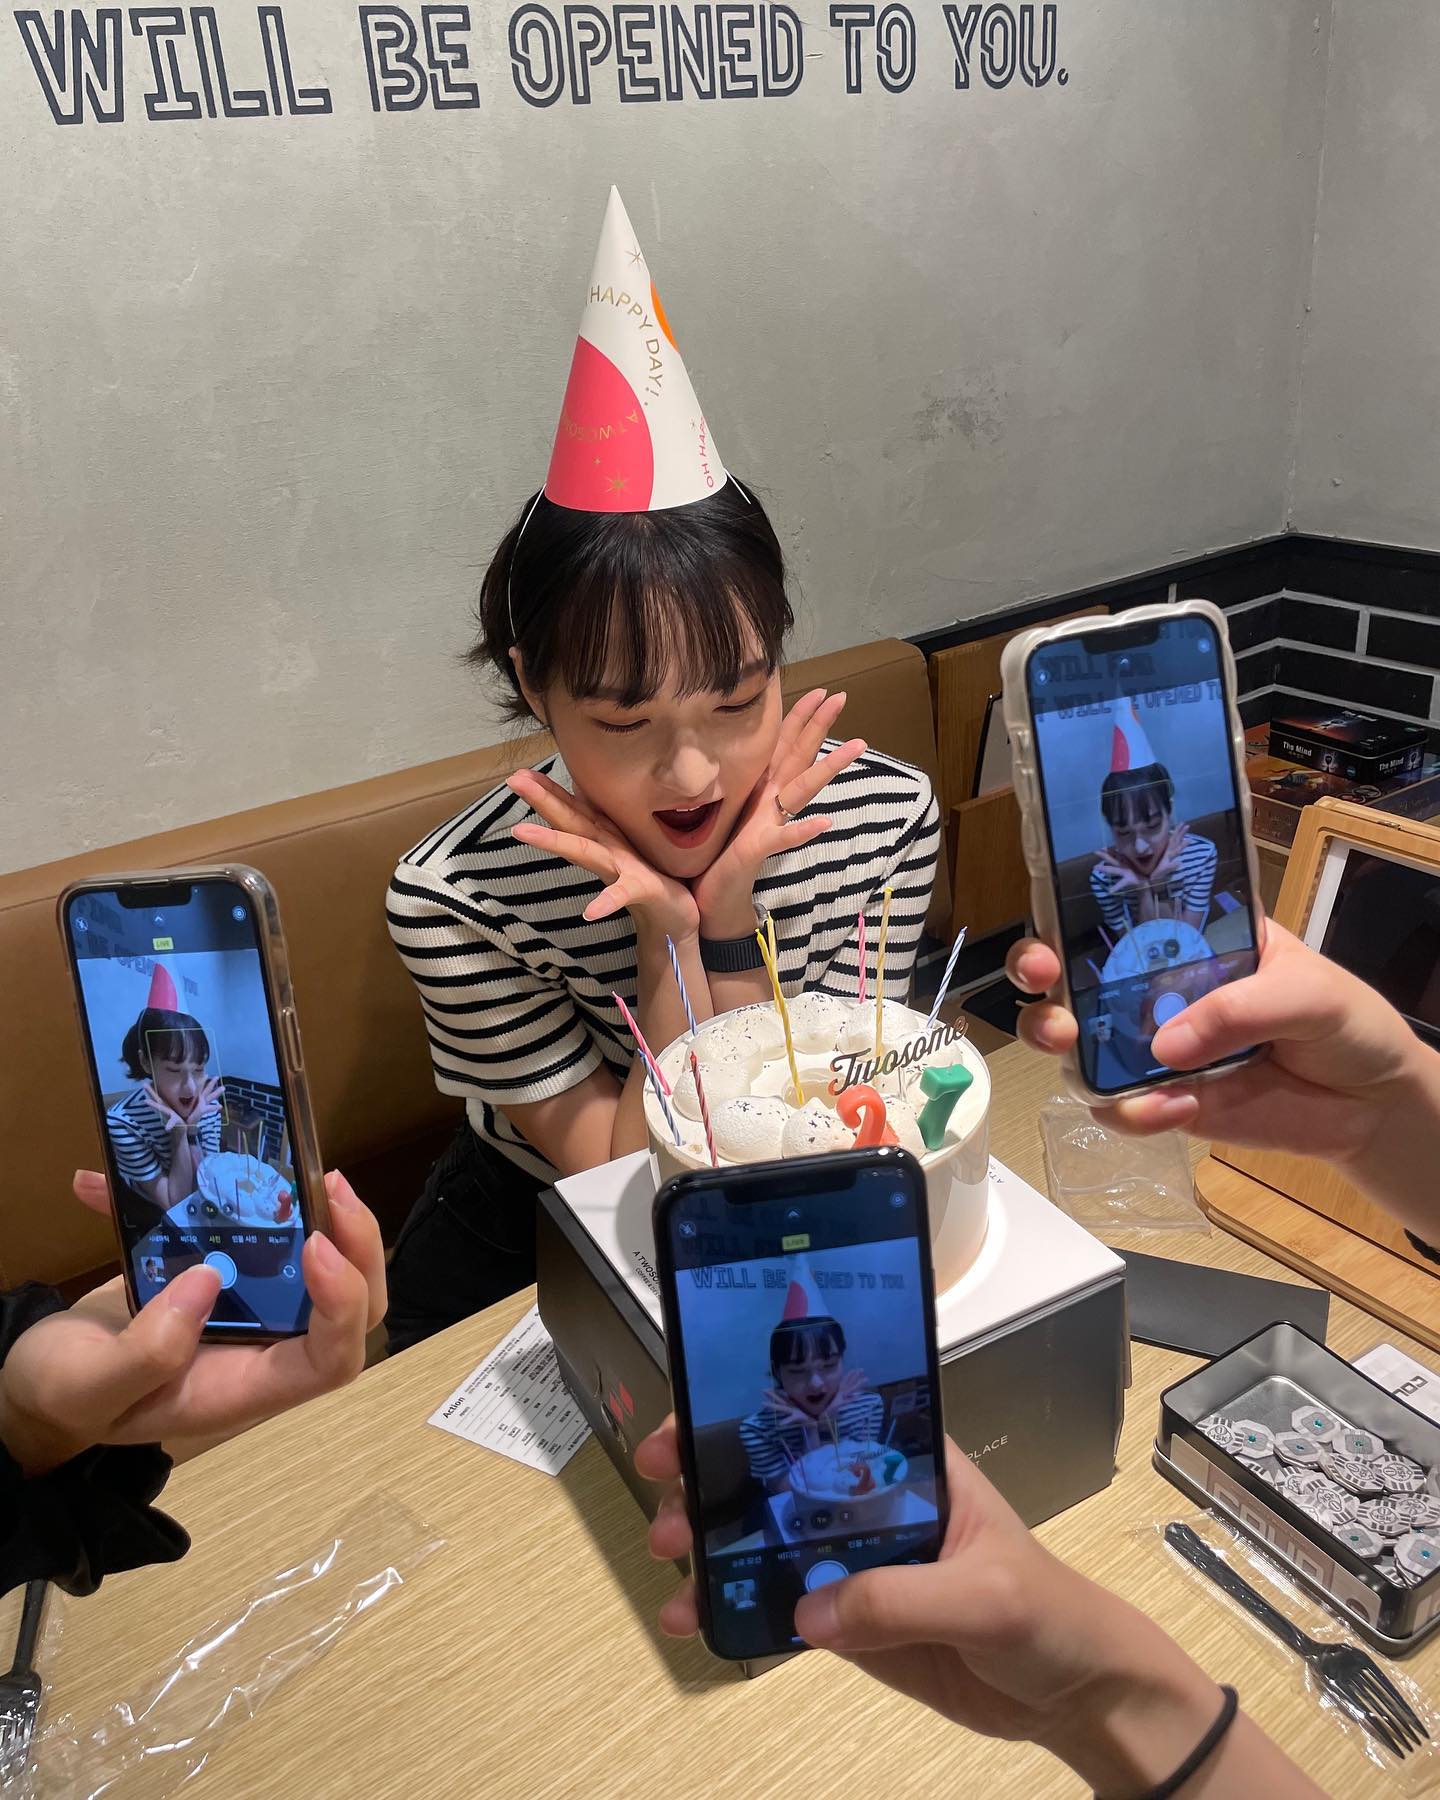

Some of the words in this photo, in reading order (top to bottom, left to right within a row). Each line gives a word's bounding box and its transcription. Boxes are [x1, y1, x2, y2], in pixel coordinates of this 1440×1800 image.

[12, 7, 333, 125] WILL
[358, 4, 481, 112] BE
[510, 3, 805, 108] OPENED
[830, 4, 917, 94] TO
[942, 4, 1069, 90] YOU.
[590, 284, 653, 330] HAPPY
[701, 463, 715, 489] OH
[1283, 740, 1294, 751] The
[1295, 744, 1312, 757] Mind
[827, 1016, 970, 1096] Twosome
[632, 1250, 641, 1258] A
[690, 1266, 757, 1289] WILL
[443, 1396, 465, 1419] Action
